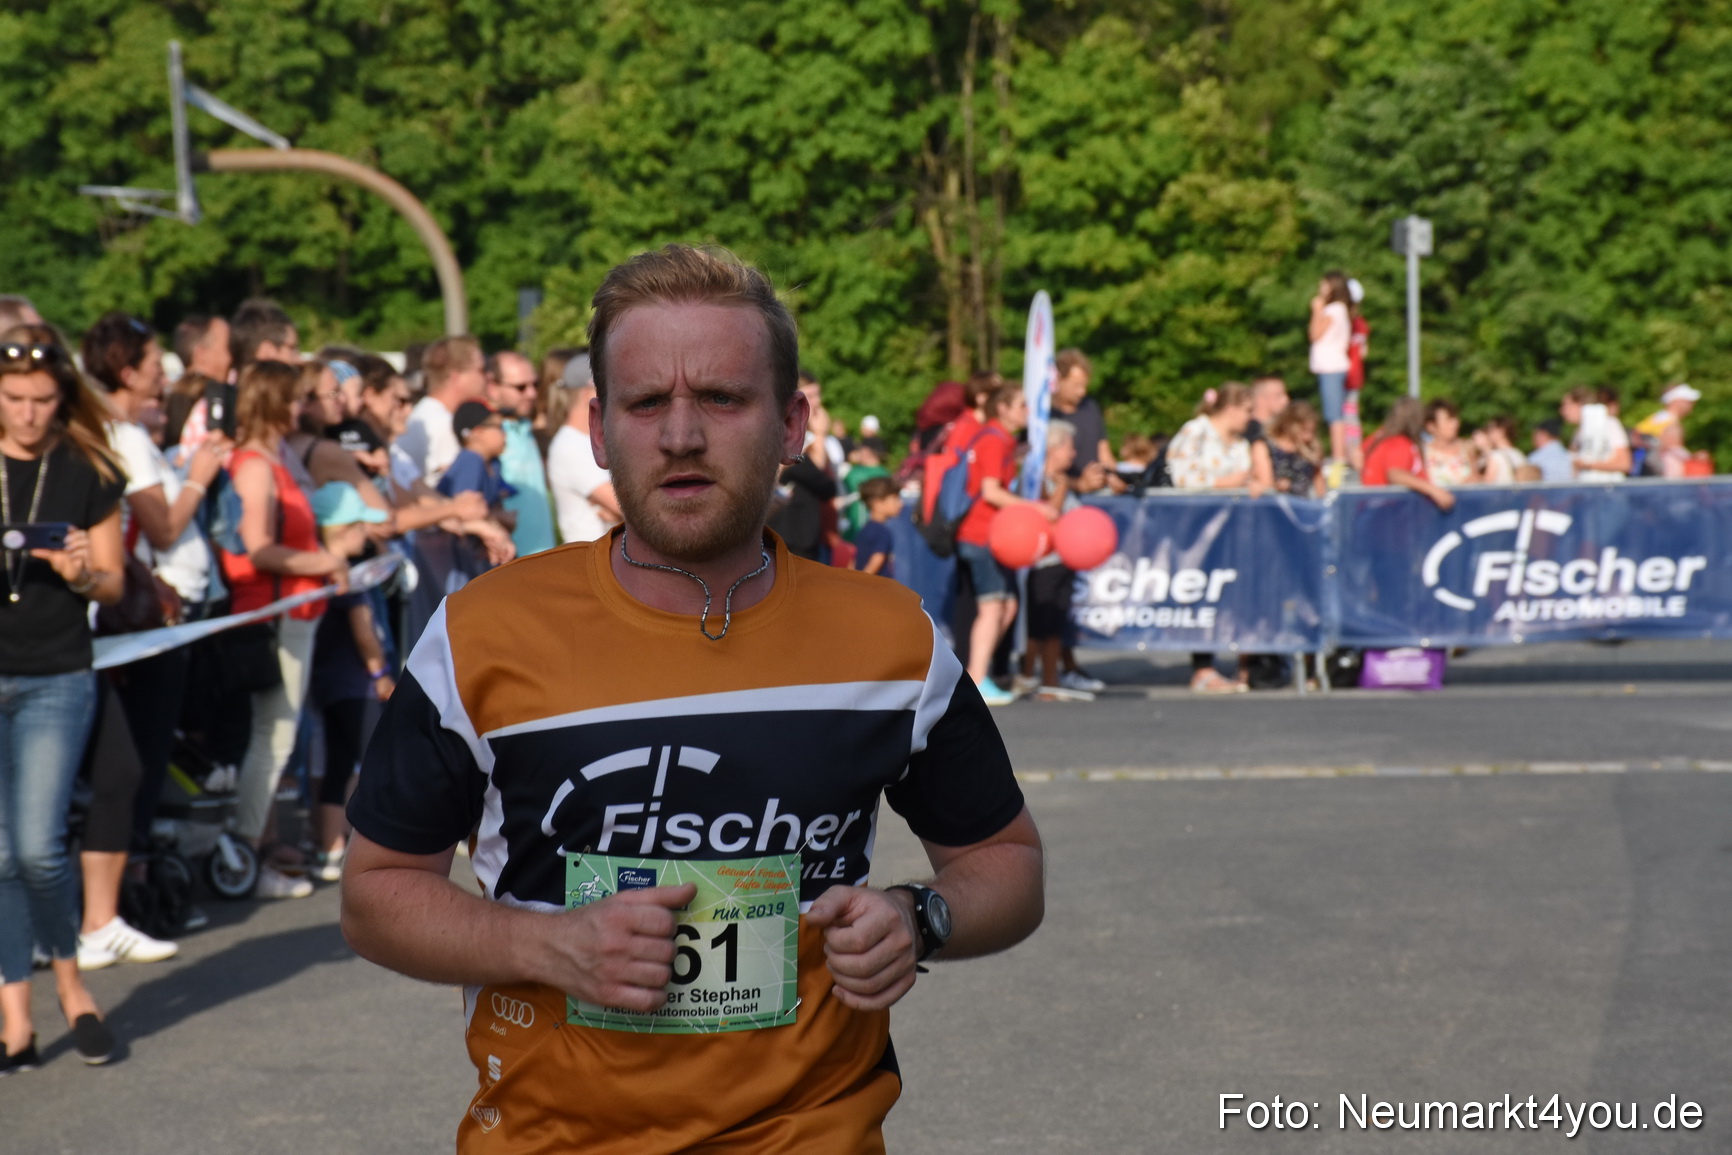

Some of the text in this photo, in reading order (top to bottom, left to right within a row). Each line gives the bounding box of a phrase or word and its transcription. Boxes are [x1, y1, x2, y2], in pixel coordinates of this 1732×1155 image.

[1072, 556, 1238, 604] cher
[1472, 546, 1708, 597] Fischer
[1073, 606, 1218, 629] TOMOBILE
[1494, 595, 1688, 623] AUTOMOBILE
[597, 798, 861, 854] Fischer
[717, 866, 756, 878] Gesunde
[712, 902, 785, 920] run 2019
[670, 923, 738, 985] 61
[690, 987, 761, 1005] Stephan
[650, 1005, 719, 1018] Automobile
[723, 1002, 758, 1015] GmbH
[489, 1022, 507, 1036] Audi
